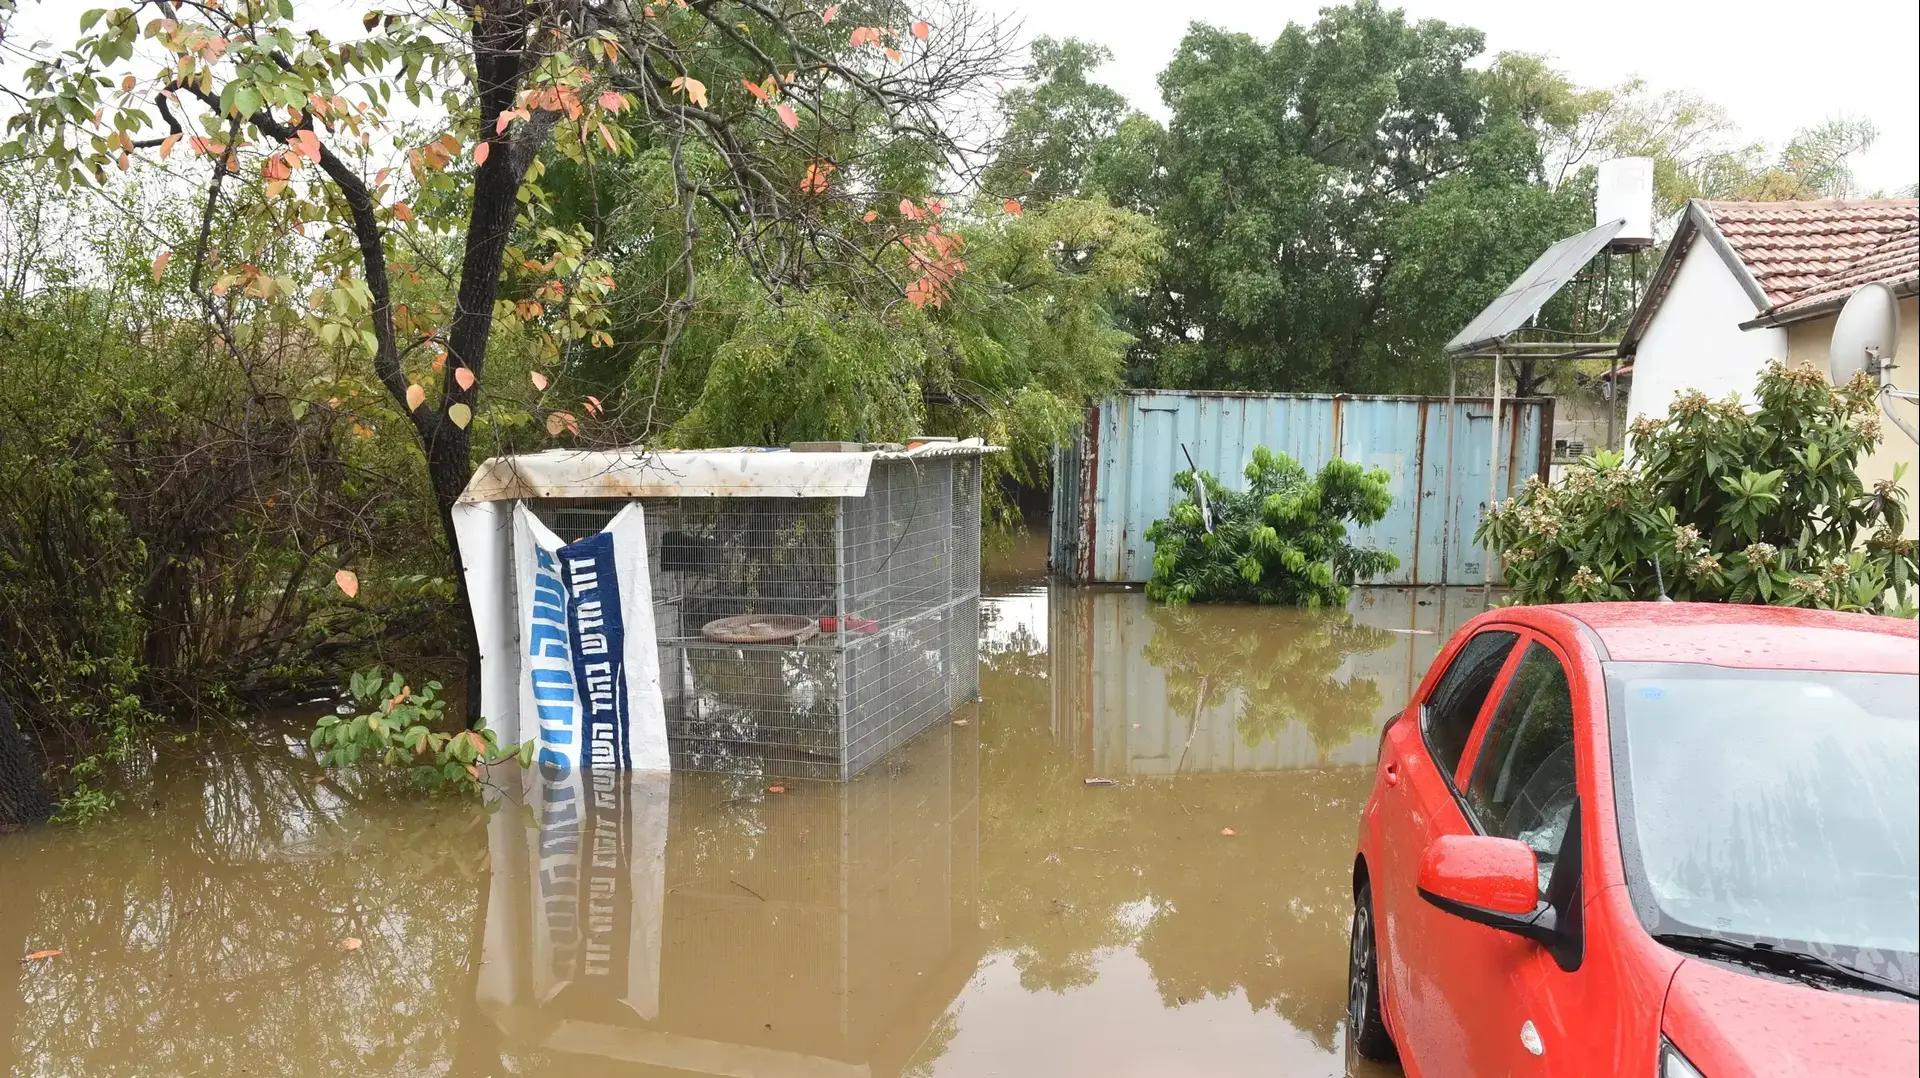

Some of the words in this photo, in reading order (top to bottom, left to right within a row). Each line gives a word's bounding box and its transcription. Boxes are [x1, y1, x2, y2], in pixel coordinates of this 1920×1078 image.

[569, 558, 599, 599] דור
[577, 601, 608, 656] חדש
[585, 661, 613, 715] בהוד
[592, 722, 616, 767] הש
